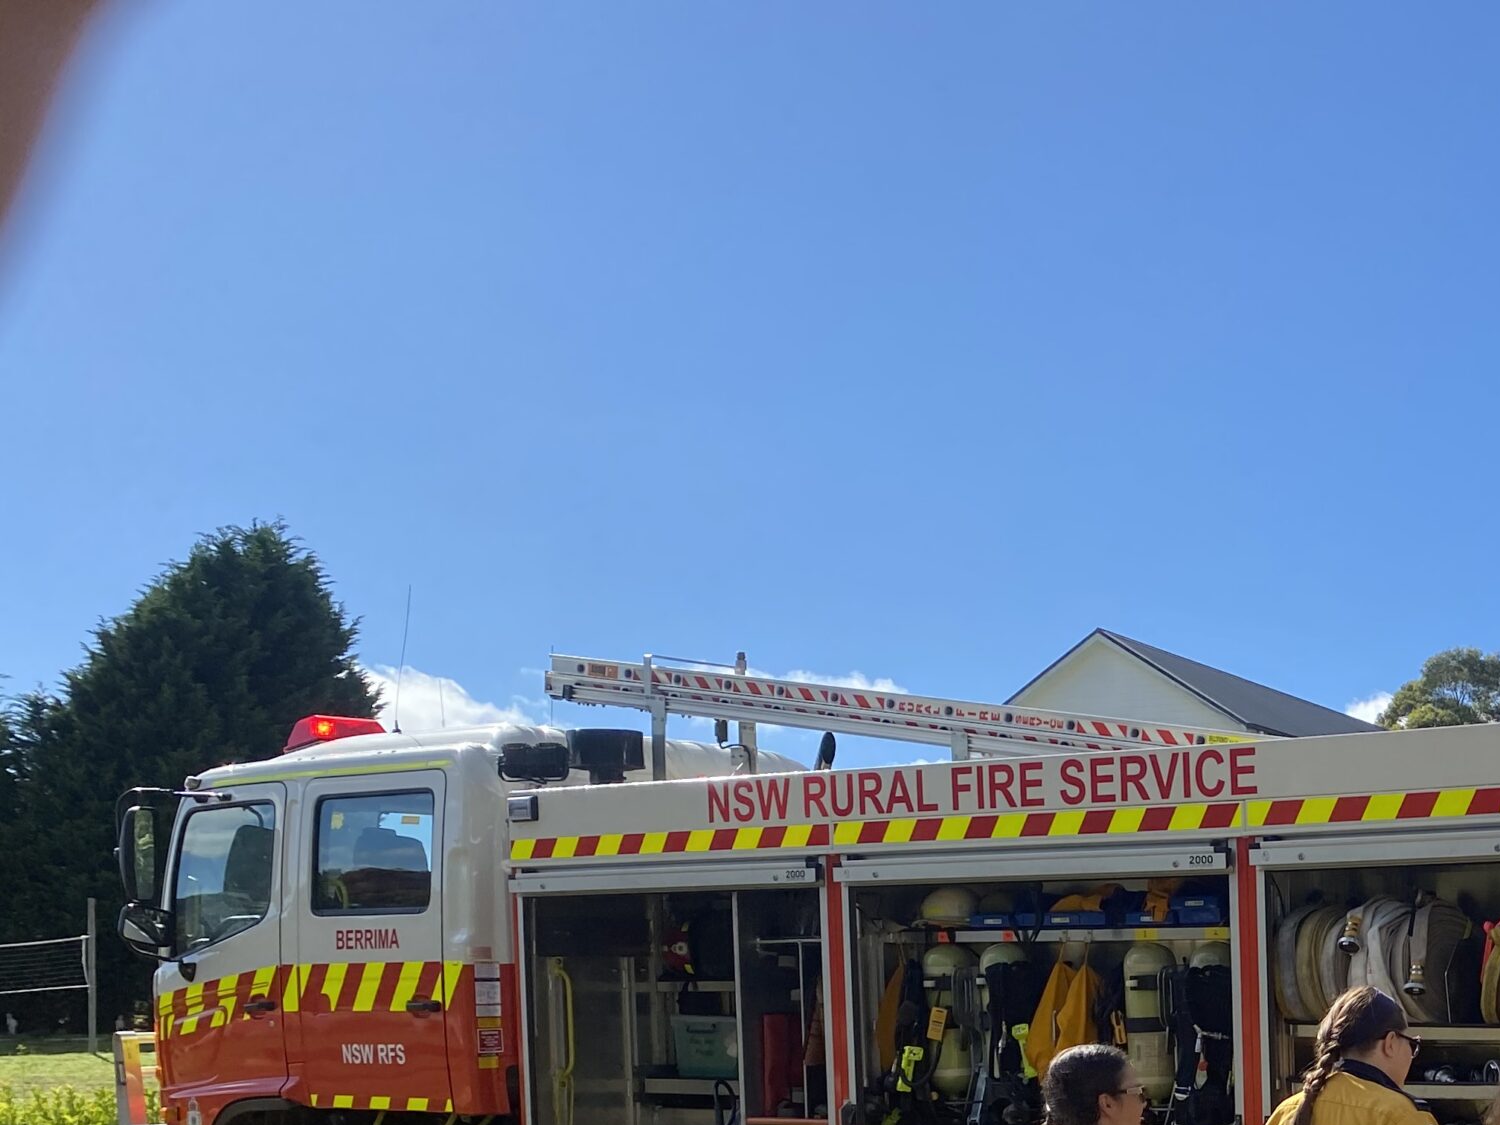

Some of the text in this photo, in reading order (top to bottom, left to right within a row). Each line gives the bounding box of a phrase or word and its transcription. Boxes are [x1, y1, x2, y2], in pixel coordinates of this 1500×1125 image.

[707, 746, 1258, 823] NSW RURAL FIRE SERVICE
[1189, 855, 1213, 864] 2000
[785, 870, 805, 879] 2000
[336, 928, 400, 950] BERRIMA
[341, 1043, 406, 1065] NSW RFS
